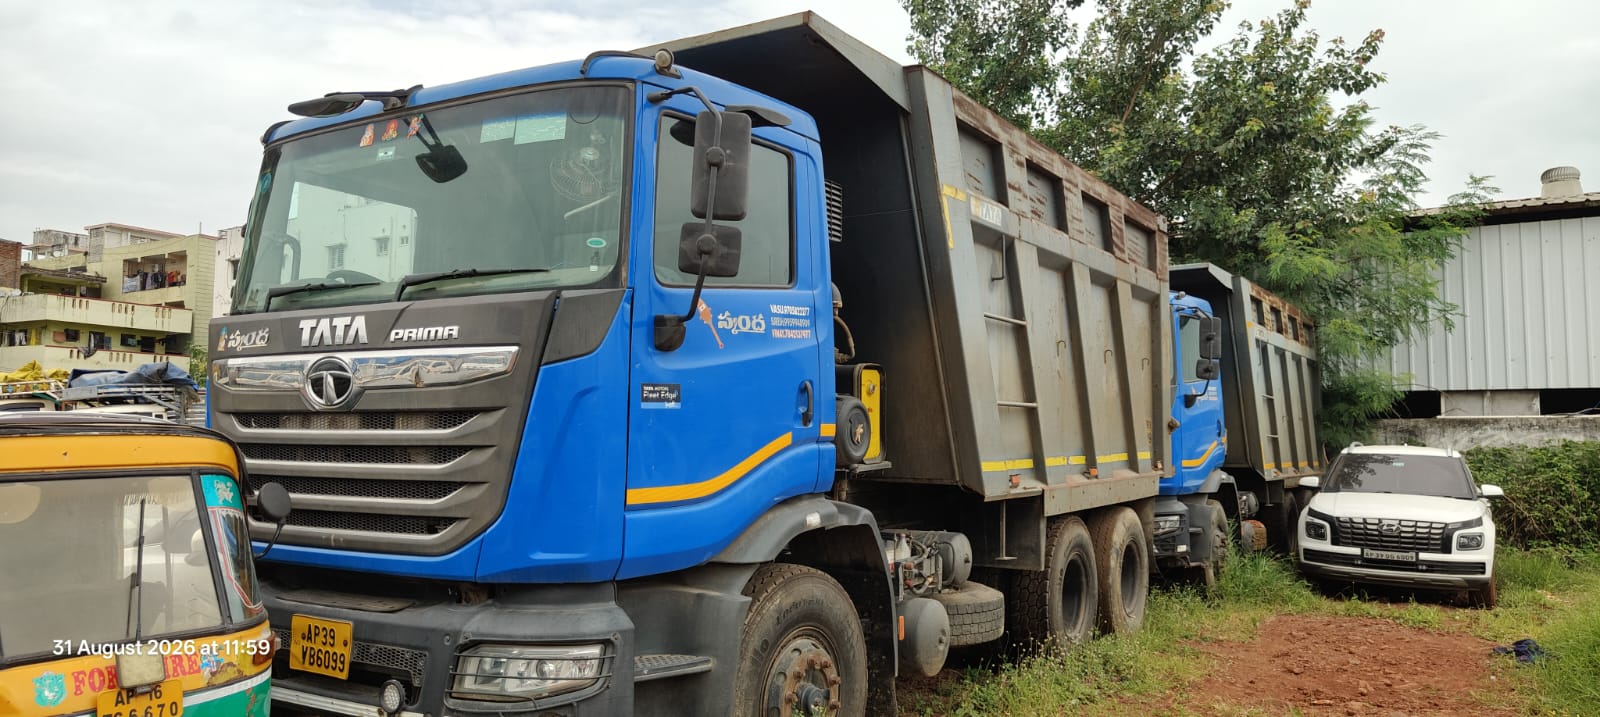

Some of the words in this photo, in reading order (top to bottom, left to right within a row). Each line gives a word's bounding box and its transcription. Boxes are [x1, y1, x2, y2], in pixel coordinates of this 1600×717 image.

[299, 315, 368, 347] TATA
[390, 326, 460, 343] PRIMA
[306, 623, 336, 647] AP39
[163, 653, 202, 680] IRE
[302, 645, 346, 673] VB6099
[102, 701, 179, 717] 6670
[114, 687, 136, 707] AP
